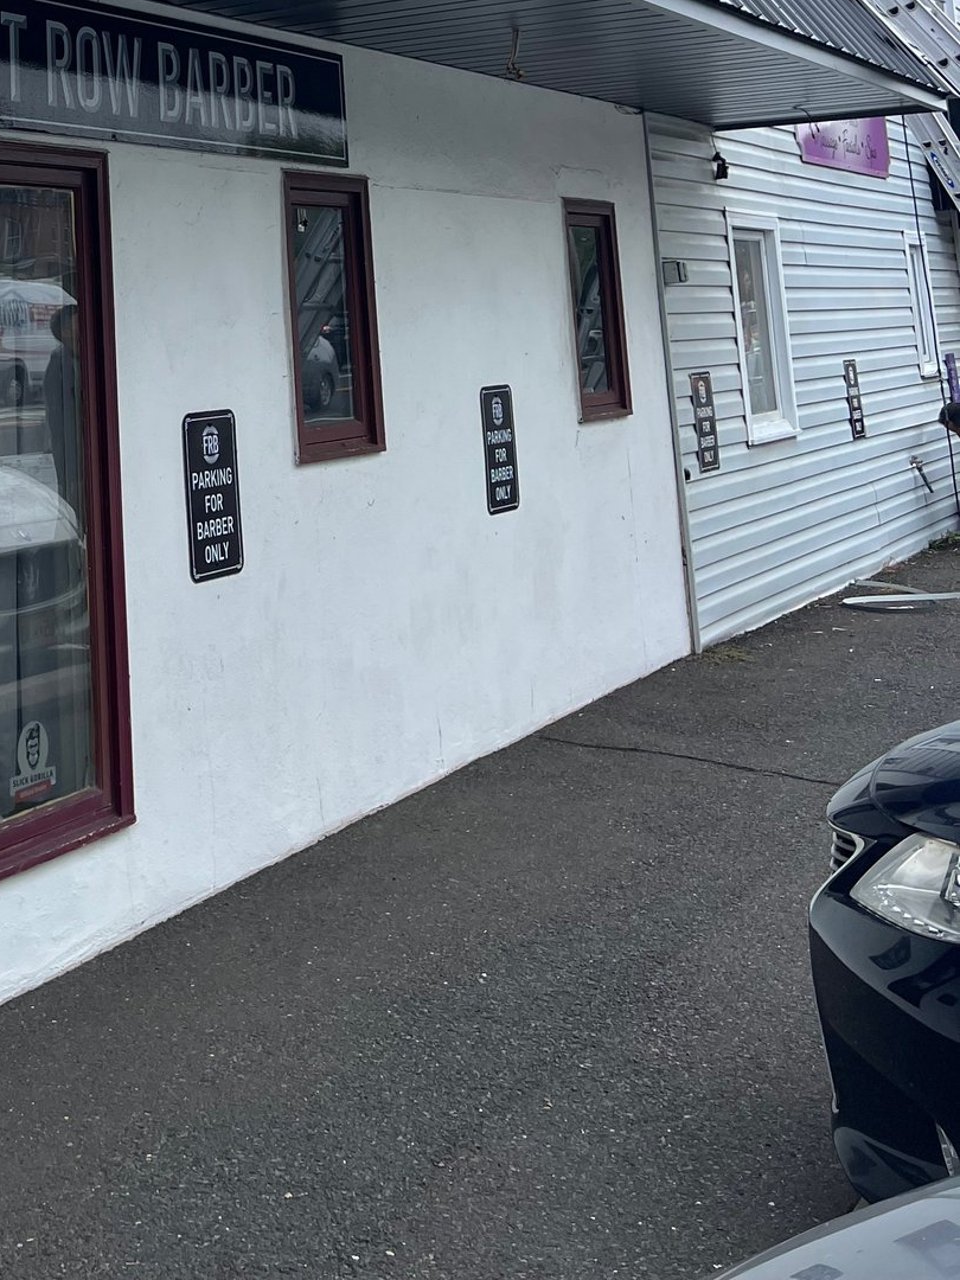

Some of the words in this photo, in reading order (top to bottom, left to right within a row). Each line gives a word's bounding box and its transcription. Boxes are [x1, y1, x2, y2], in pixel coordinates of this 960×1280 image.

[46, 20, 141, 117] ROW
[158, 41, 296, 138] BARBER
[203, 435, 219, 455] FRB
[487, 428, 512, 445] PARKING
[495, 448, 507, 463] FOR
[192, 467, 232, 491] PARKING
[491, 465, 514, 483] BARBER
[495, 484, 511, 501] ONLY
[205, 493, 224, 513] FOR
[197, 516, 234, 540] BARBER
[205, 541, 230, 564] ONLY
